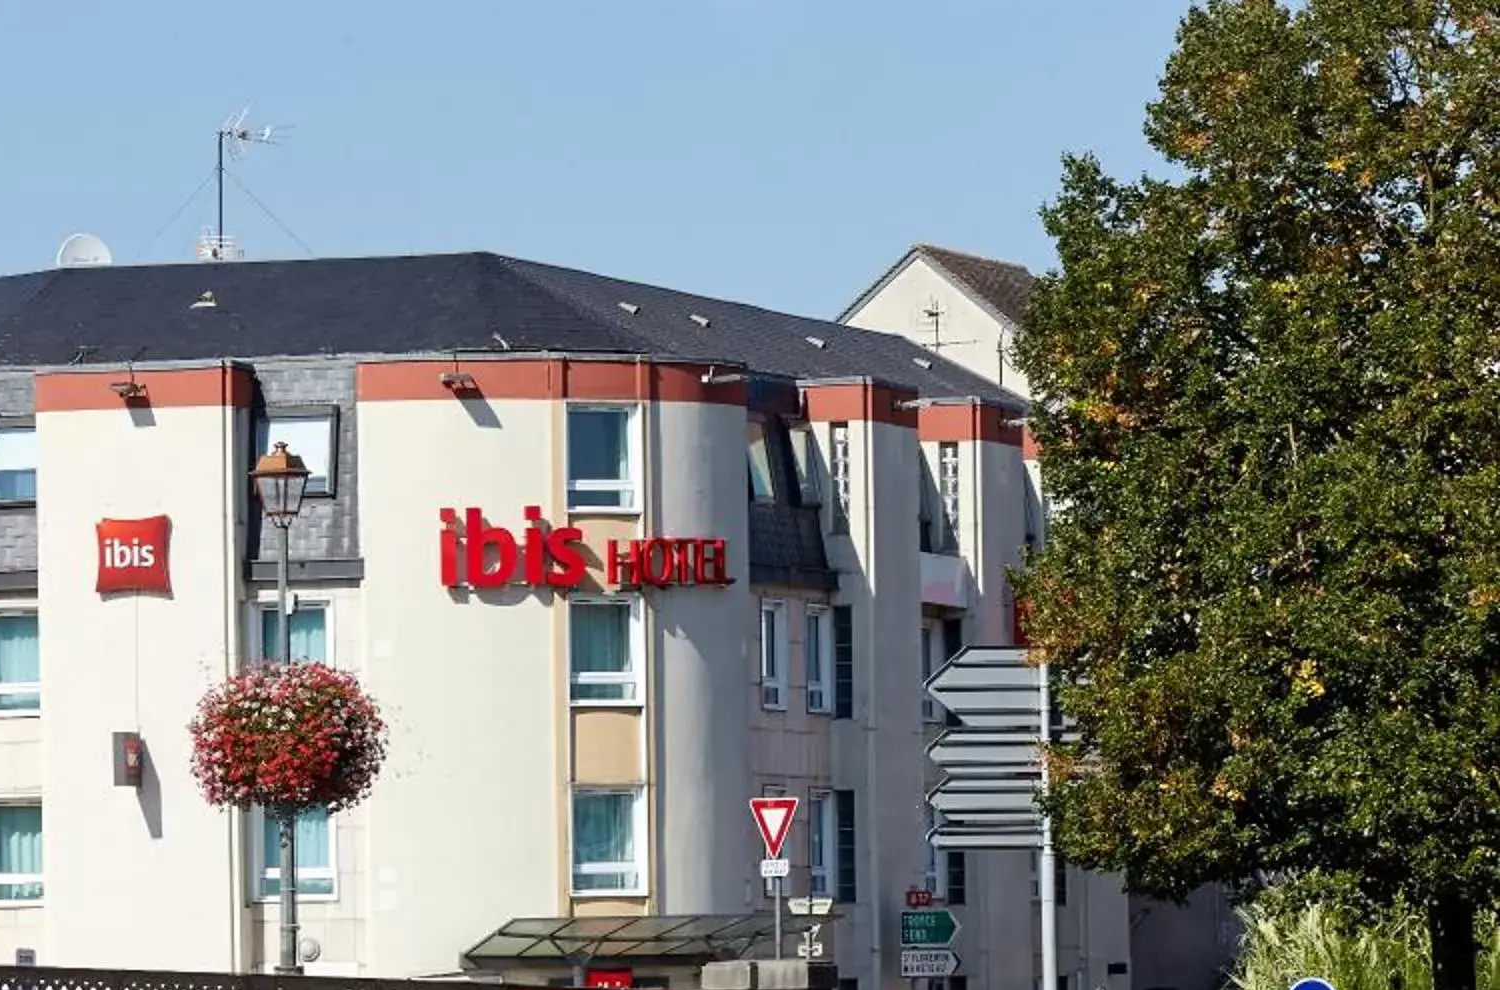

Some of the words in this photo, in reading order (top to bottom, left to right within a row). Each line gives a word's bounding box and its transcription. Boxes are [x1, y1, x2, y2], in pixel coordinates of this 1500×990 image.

[104, 537, 155, 569] ibis
[440, 506, 586, 587] ibis
[607, 537, 736, 588] HOTEL
